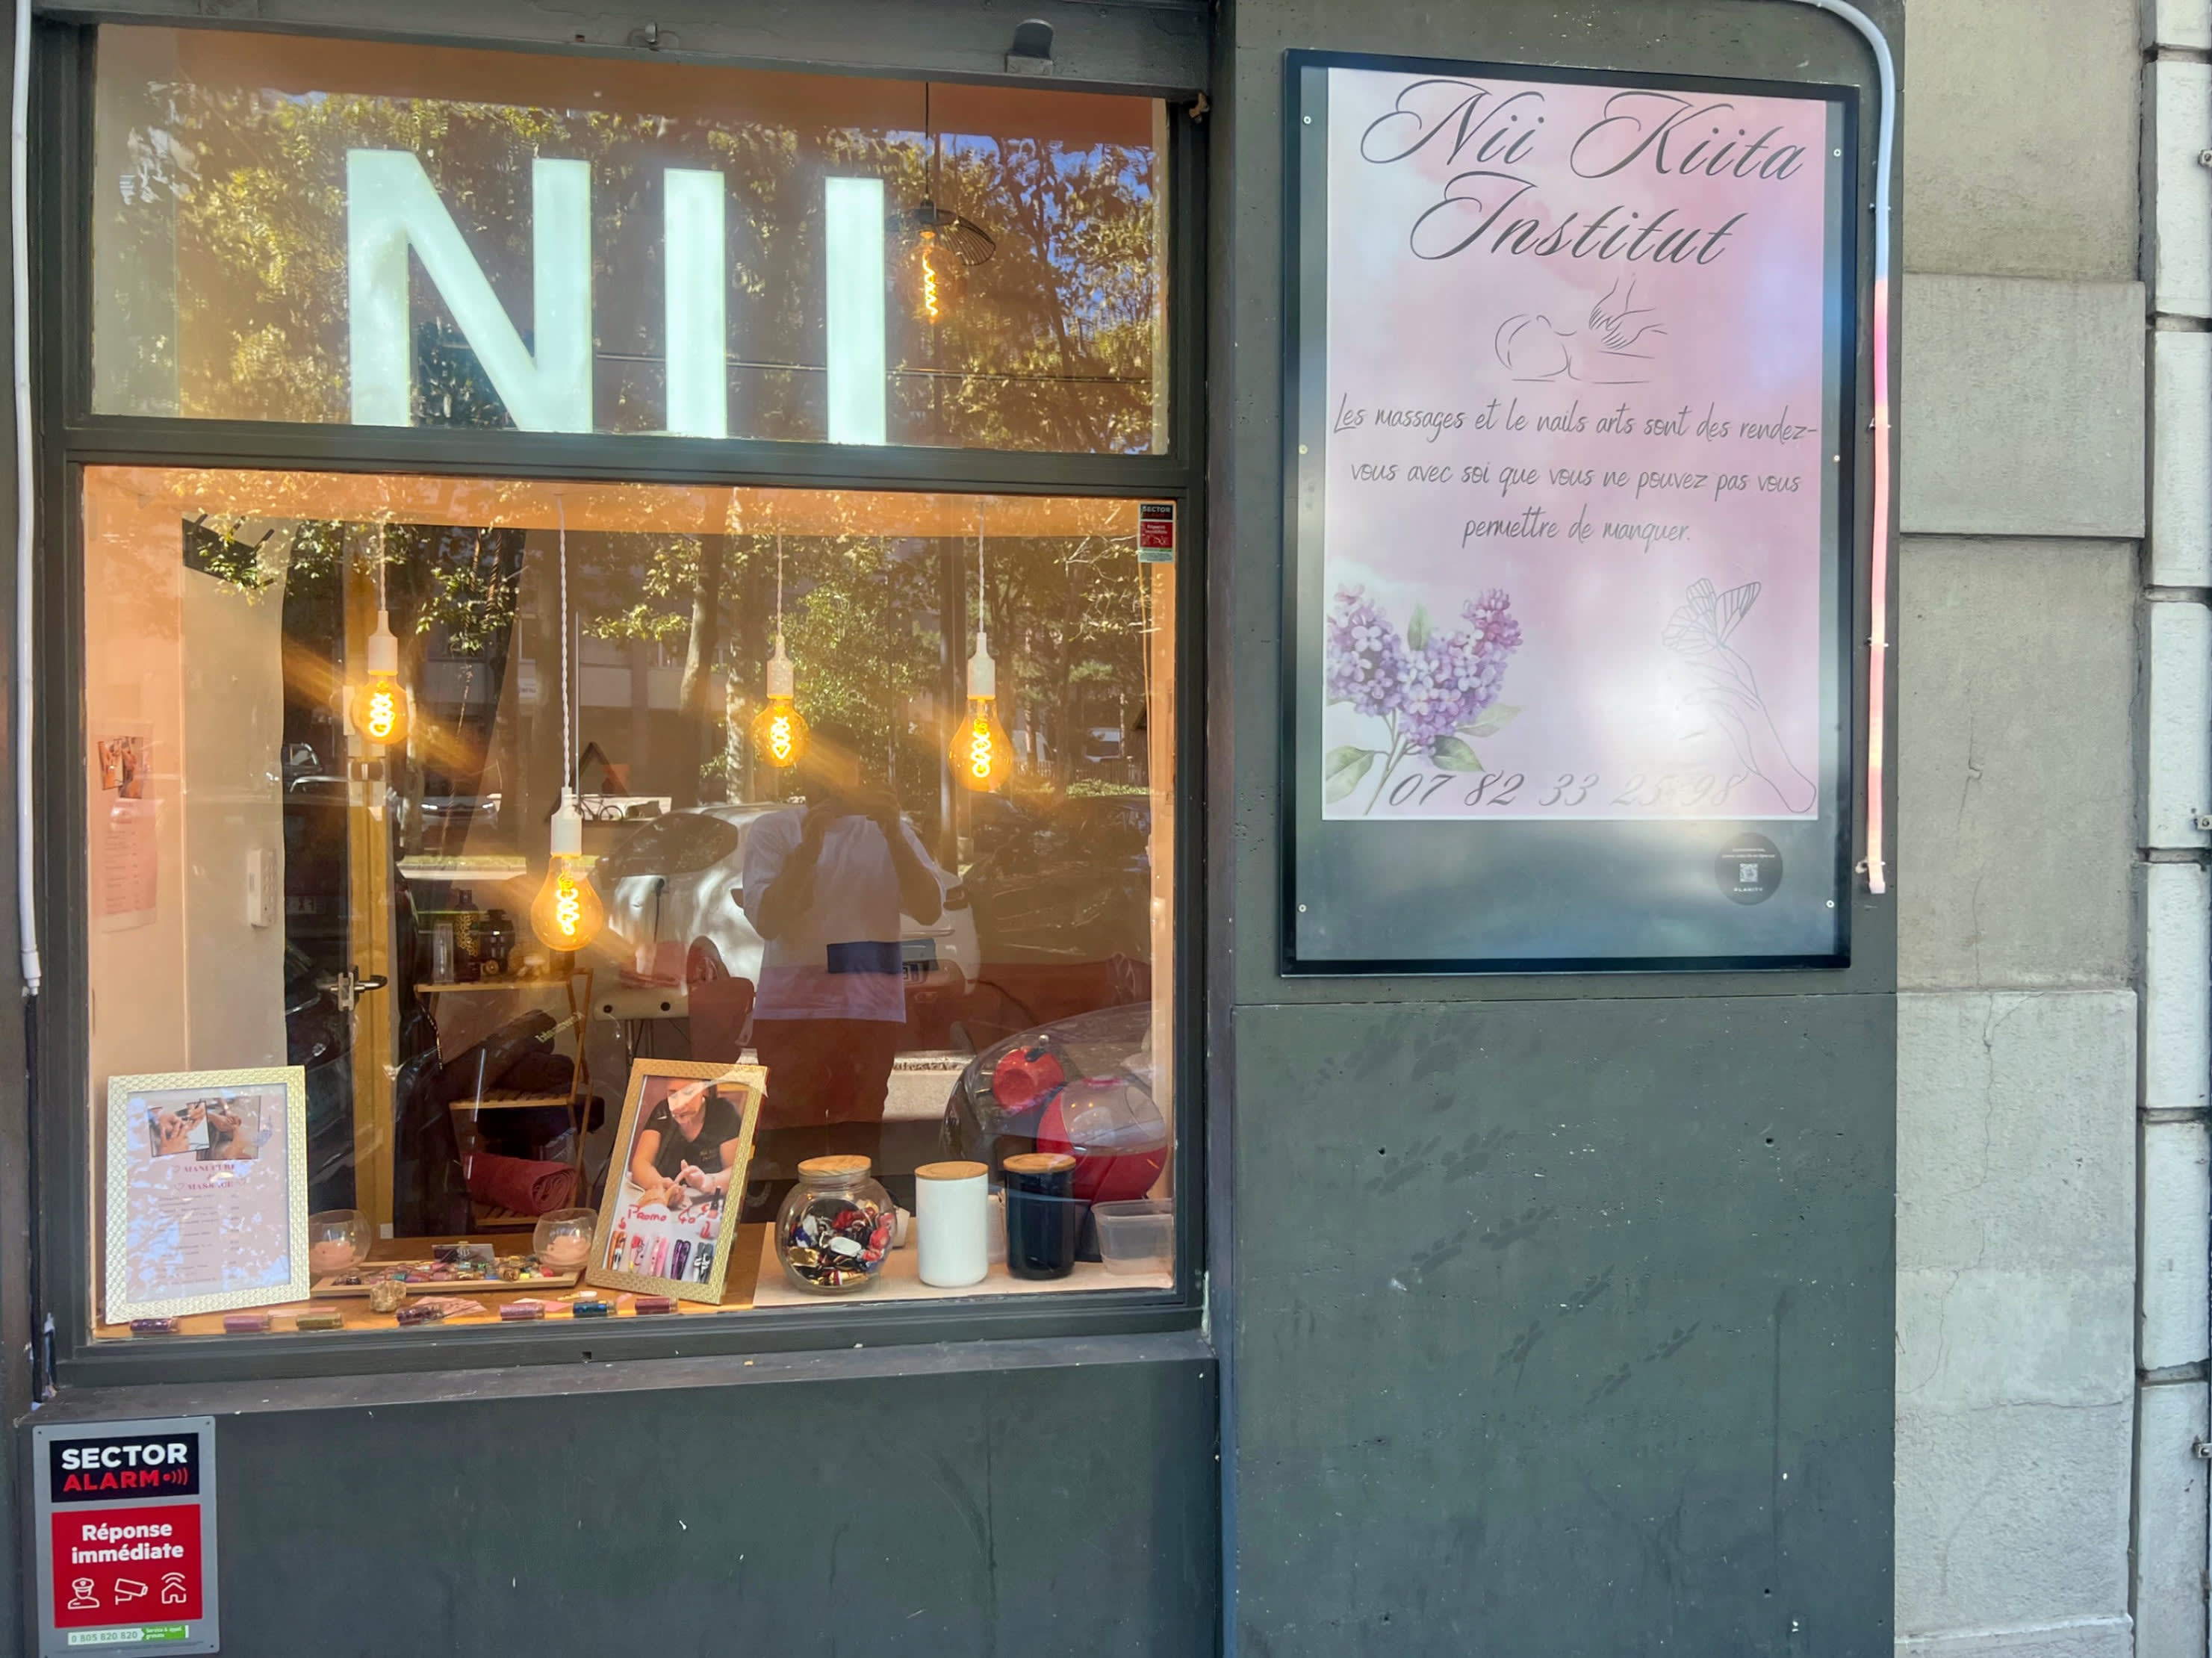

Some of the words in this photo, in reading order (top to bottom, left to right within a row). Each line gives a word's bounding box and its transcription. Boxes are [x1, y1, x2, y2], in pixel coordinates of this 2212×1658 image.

[1360, 79, 1546, 167] Nii
[1570, 90, 1807, 180] Kiita
[1410, 170, 1747, 265] Institut
[347, 149, 886, 445] NII
[1334, 392, 1366, 433] Les
[1375, 409, 1467, 443] massages
[1475, 398, 1501, 430] et
[1506, 397, 1528, 431] le
[1537, 400, 1588, 432] nails
[1596, 402, 1635, 435] arts
[1643, 406, 1692, 436] sont
[1697, 402, 1731, 442] des
[1739, 405, 1817, 444] rendez-
[1351, 463, 1399, 481] vous
[1408, 465, 1453, 483] avec
[1461, 462, 1491, 484] soi
[1499, 466, 1540, 498] que
[1549, 468, 1594, 486] vous
[1603, 471, 1630, 488] ne
[1635, 471, 1709, 500] pouvez
[1714, 472, 1749, 502] pas
[1757, 475, 1802, 493] vous
[1568, 503, 1595, 544] de
[1602, 521, 1691, 554] manquer.
[1389, 773, 1456, 806] 07
[1464, 771, 1525, 807] 82
[1539, 773, 1599, 807] 33
[61, 1443, 187, 1470] SECTOR
[63, 1471, 159, 1492] ALARM
[82, 1523, 173, 1544] Réponse
[72, 1543, 184, 1564] immédiate
[80, 1634, 97, 1642] 805
[100, 1633, 118, 1641] 820
[120, 1631, 138, 1640] 820
